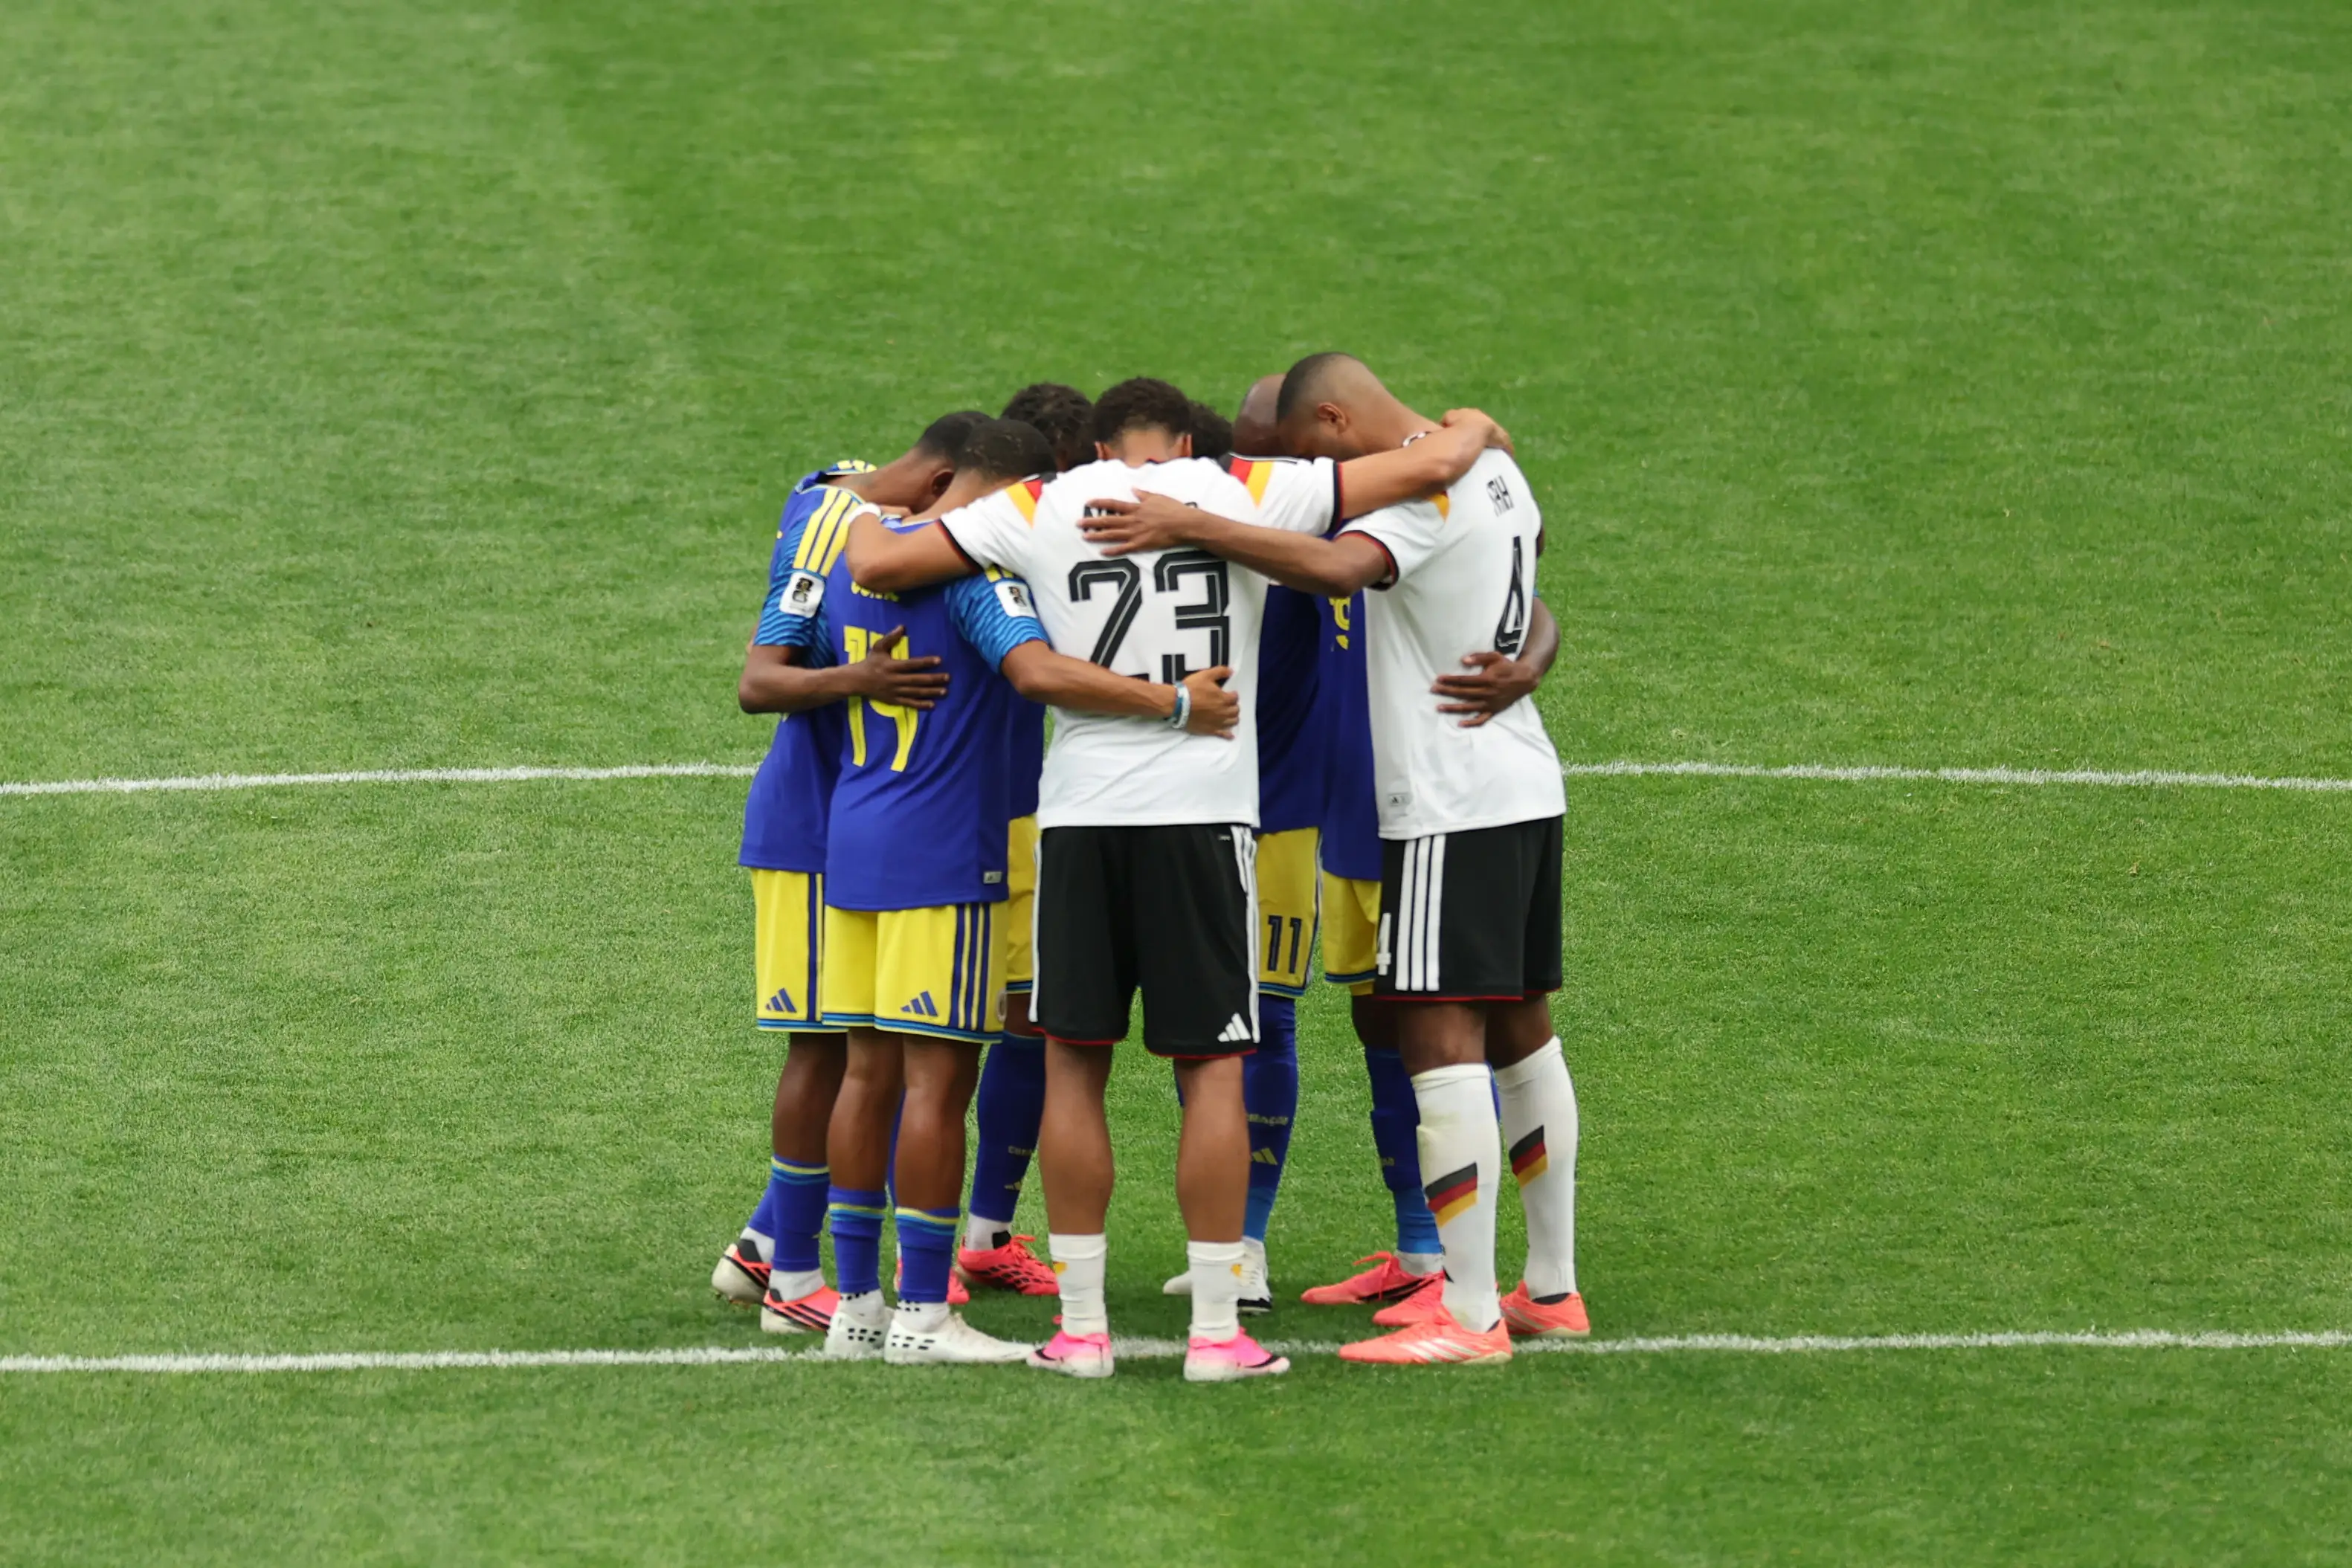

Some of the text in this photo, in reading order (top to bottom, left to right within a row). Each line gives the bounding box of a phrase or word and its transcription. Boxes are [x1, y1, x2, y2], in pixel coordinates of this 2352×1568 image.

[1068, 550, 1230, 688] 23
[1494, 535, 1524, 654] 4
[1267, 914, 1302, 974] 11
[1376, 912, 1391, 975] 4
